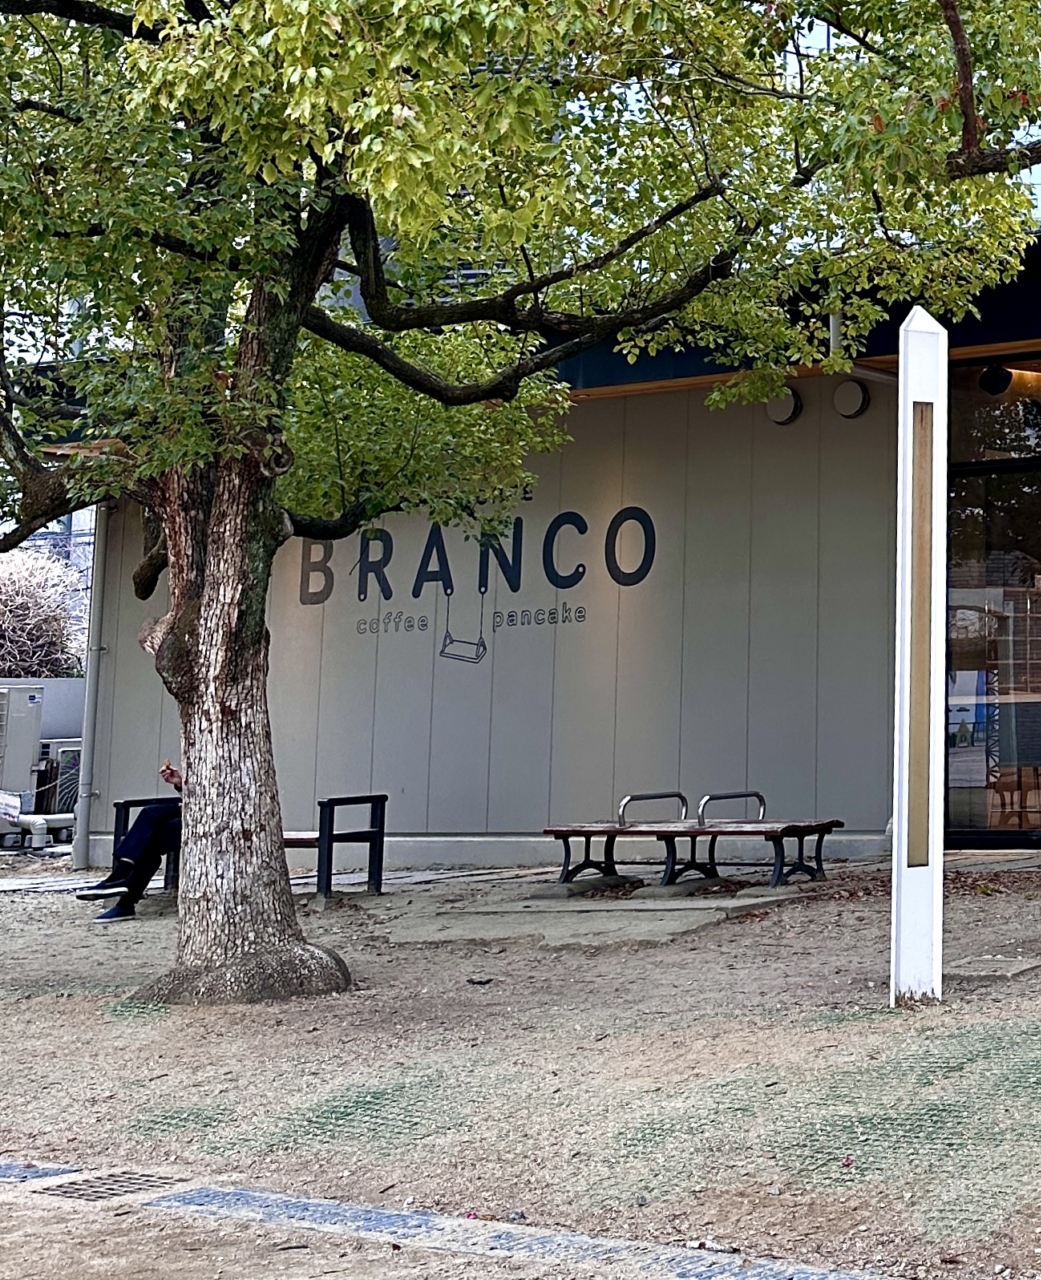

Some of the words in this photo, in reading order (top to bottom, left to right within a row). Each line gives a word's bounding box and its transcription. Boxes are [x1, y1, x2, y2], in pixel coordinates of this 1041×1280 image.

[299, 506, 656, 606] BRANCO
[357, 610, 429, 634] coffee
[492, 602, 587, 633] pancake
